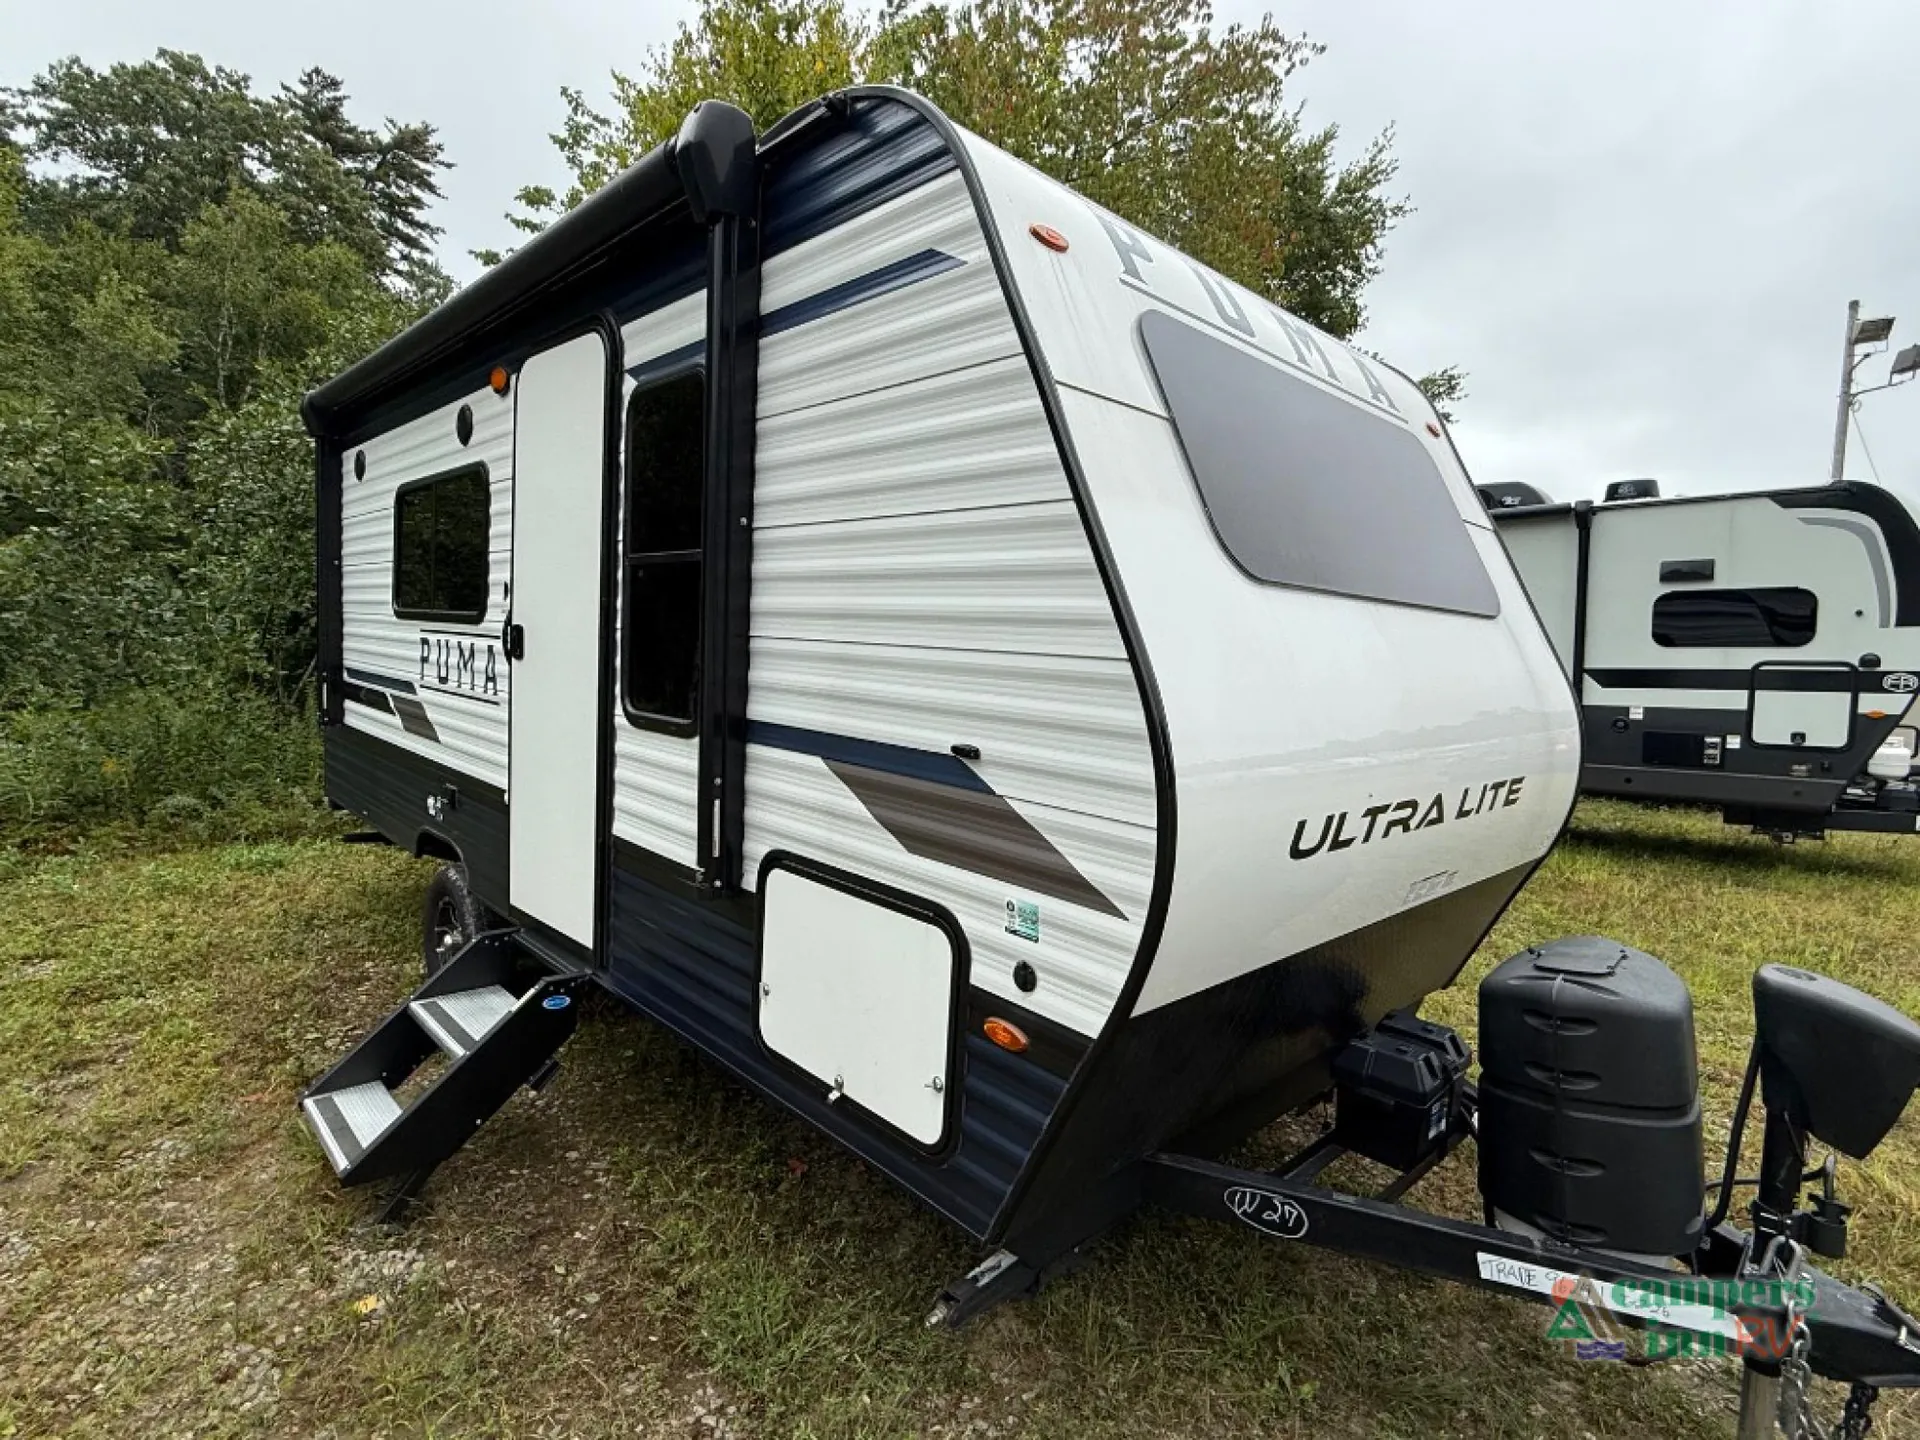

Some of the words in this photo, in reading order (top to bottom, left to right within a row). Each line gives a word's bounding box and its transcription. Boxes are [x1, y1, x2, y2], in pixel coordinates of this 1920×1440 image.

[1090, 206, 1401, 413] PUMA
[420, 637, 498, 696] PUMA
[1289, 792, 1445, 860] ULTRA
[1454, 776, 1526, 820] LITE
